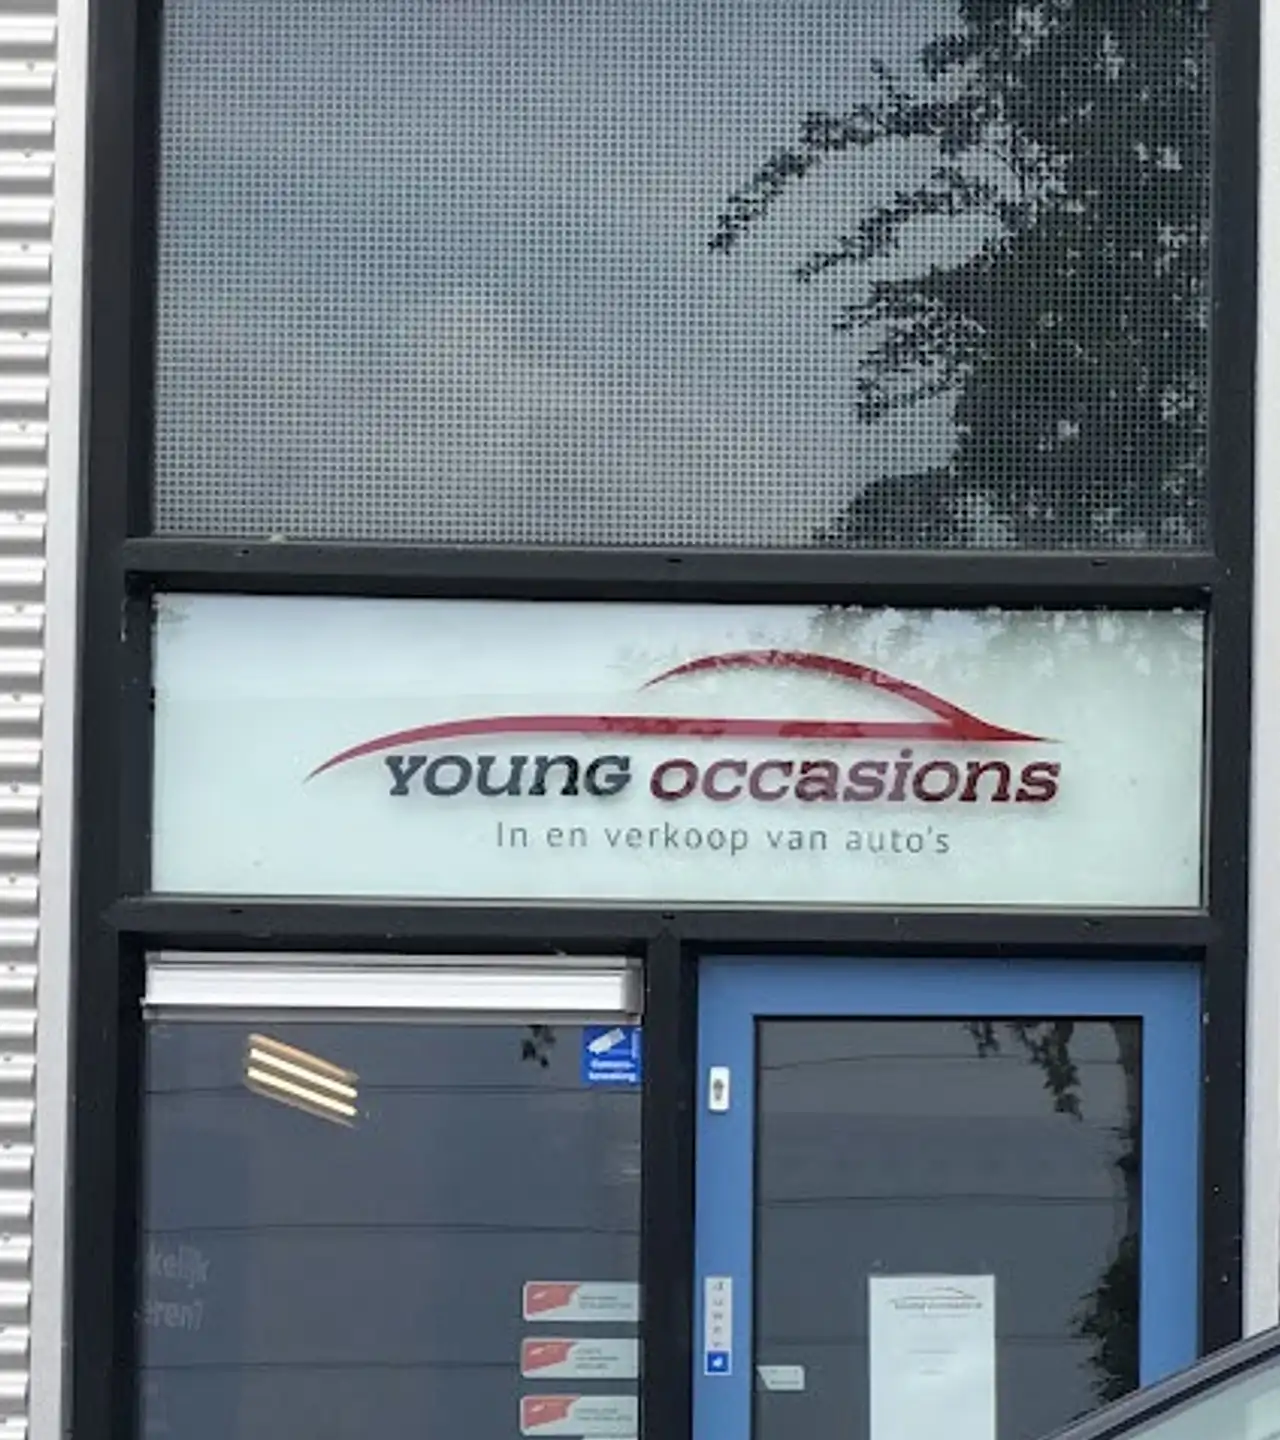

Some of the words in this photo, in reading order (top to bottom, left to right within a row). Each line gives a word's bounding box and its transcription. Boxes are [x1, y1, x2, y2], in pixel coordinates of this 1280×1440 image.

[648, 748, 1062, 803] occasions
[497, 822, 528, 848] In
[547, 827, 588, 850] en
[603, 821, 749, 855] verkoop
[766, 826, 828, 852] van
[845, 826, 951, 854] auto's
